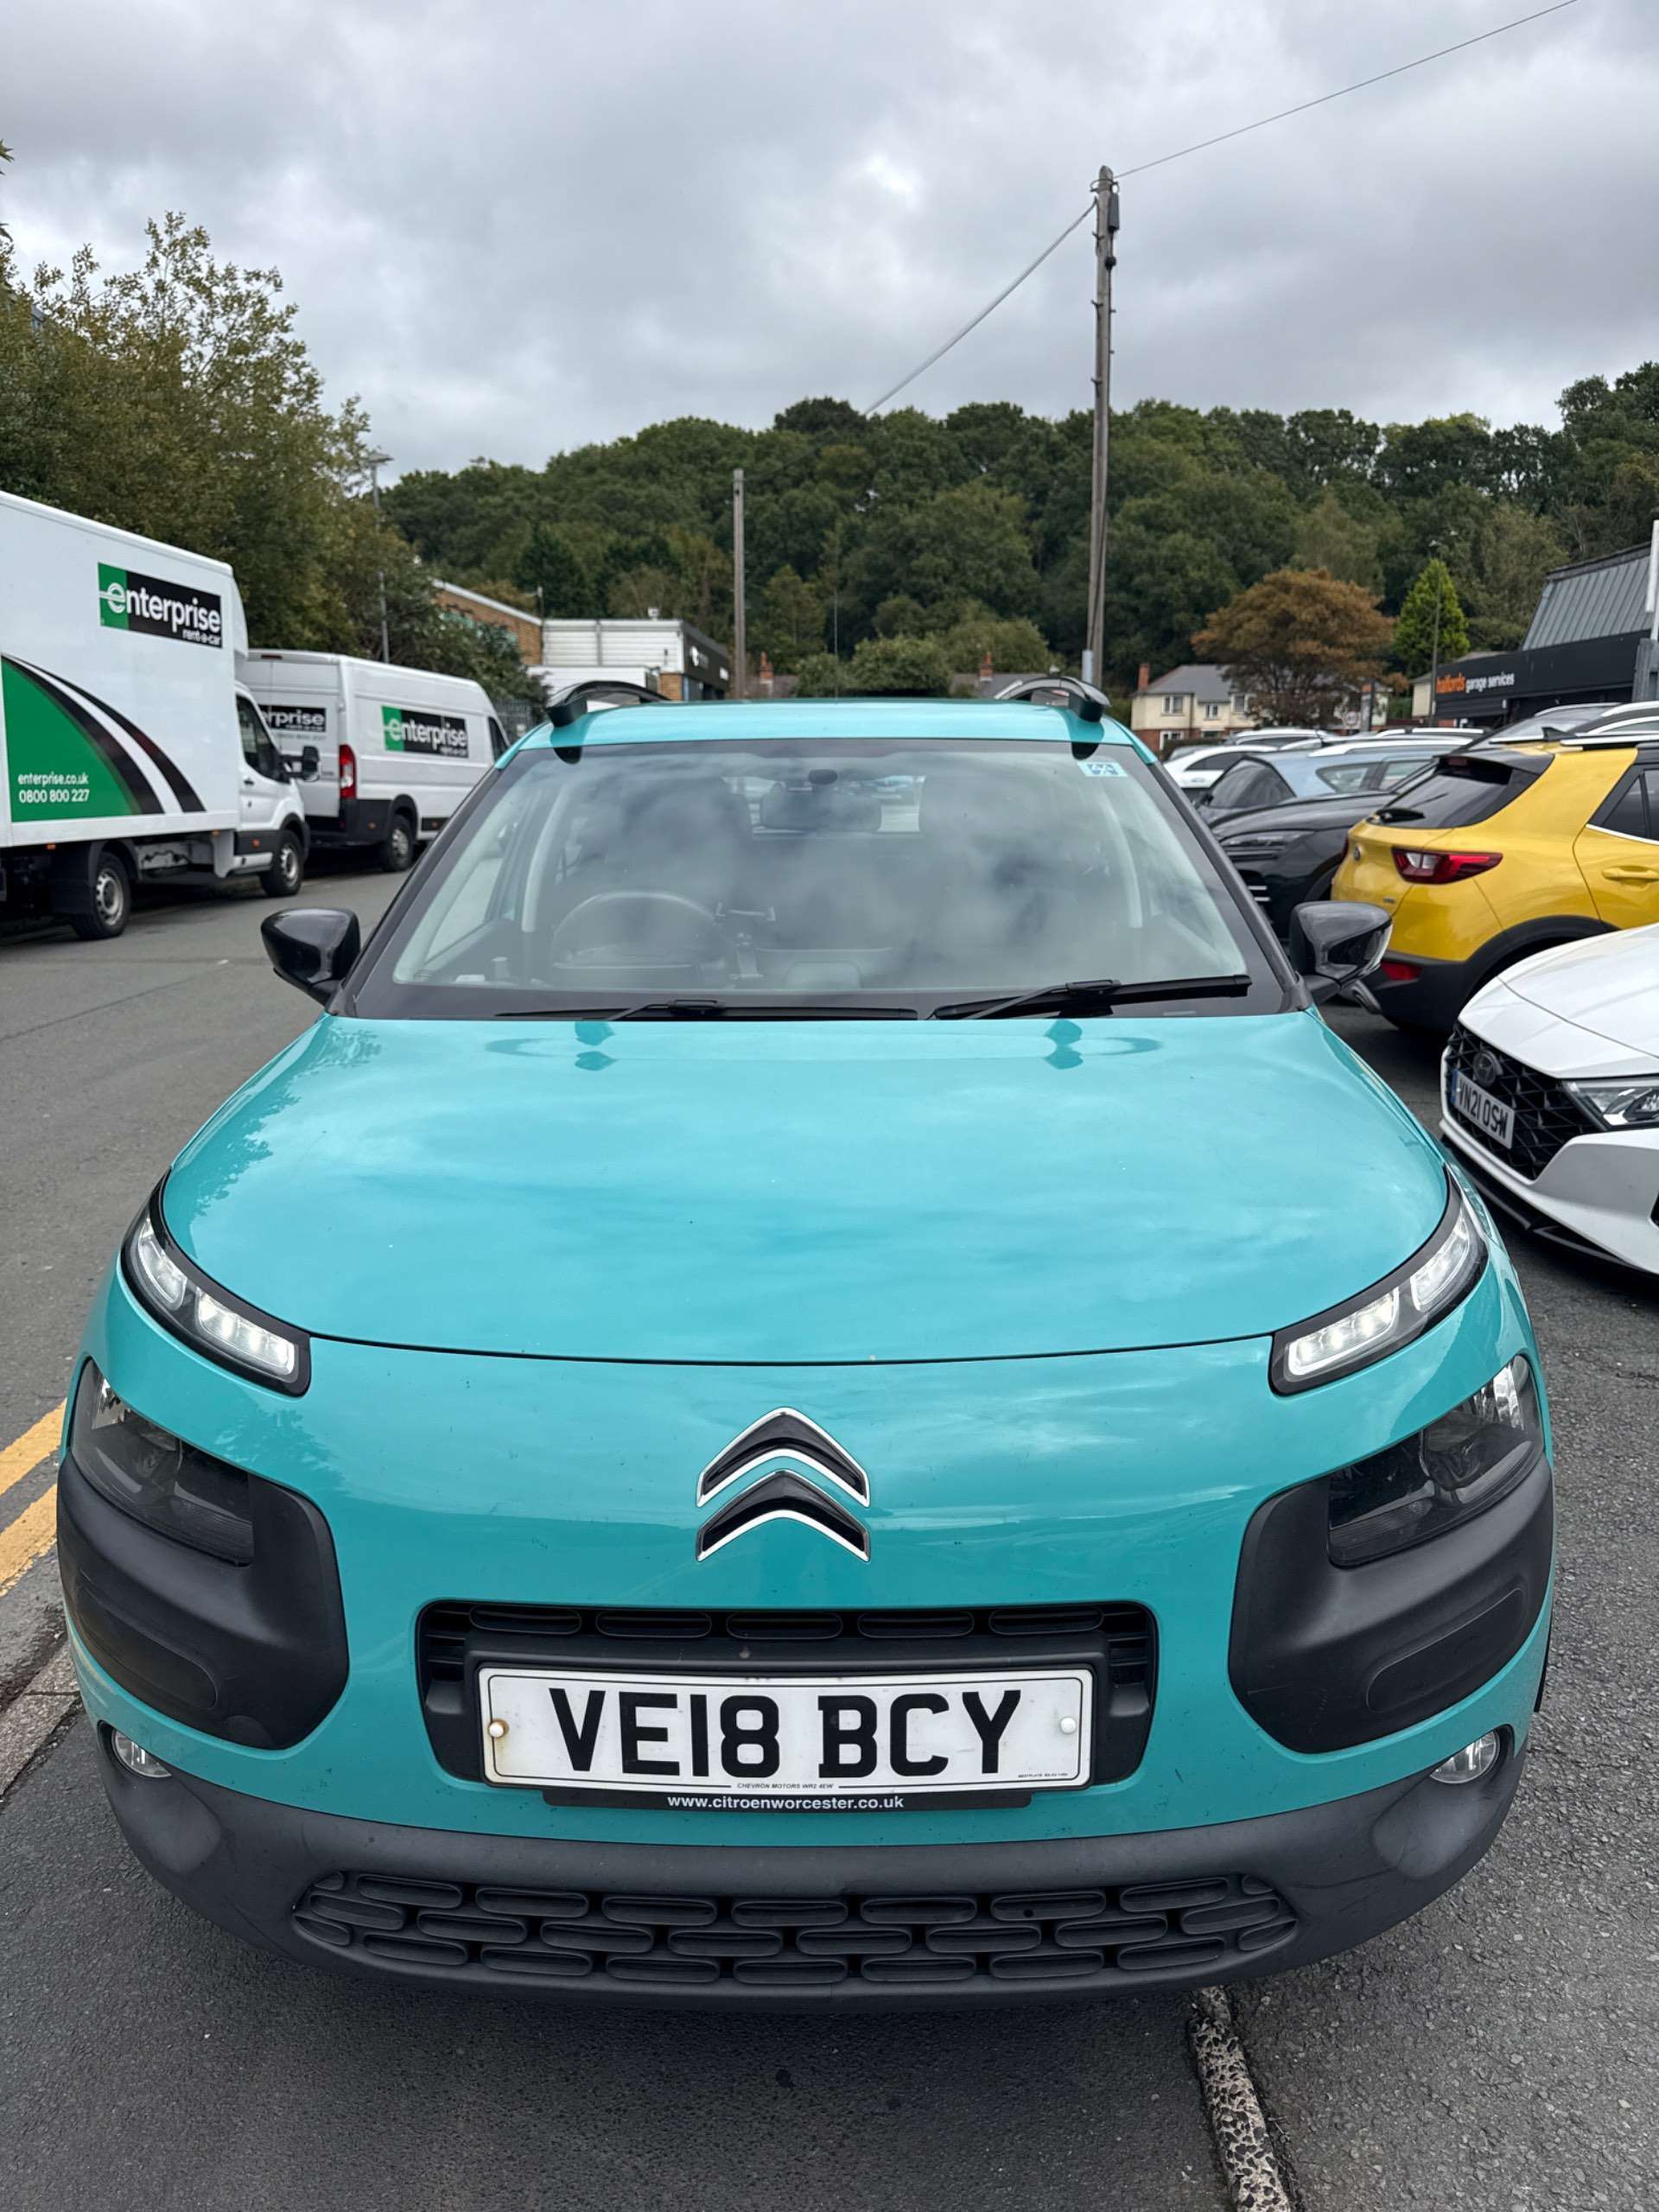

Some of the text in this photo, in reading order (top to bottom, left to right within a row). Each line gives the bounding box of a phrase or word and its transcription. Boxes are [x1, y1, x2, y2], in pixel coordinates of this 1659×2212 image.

[99, 582, 221, 632] enterprise
[384, 718, 467, 750] enterprise
[17, 771, 89, 787] enterprise.co.uk
[19, 788, 90, 804] 0800 800 227
[549, 1688, 1021, 1778] VE18 BCY
[666, 1796, 905, 1809] www.citroenworcester.co.uk
